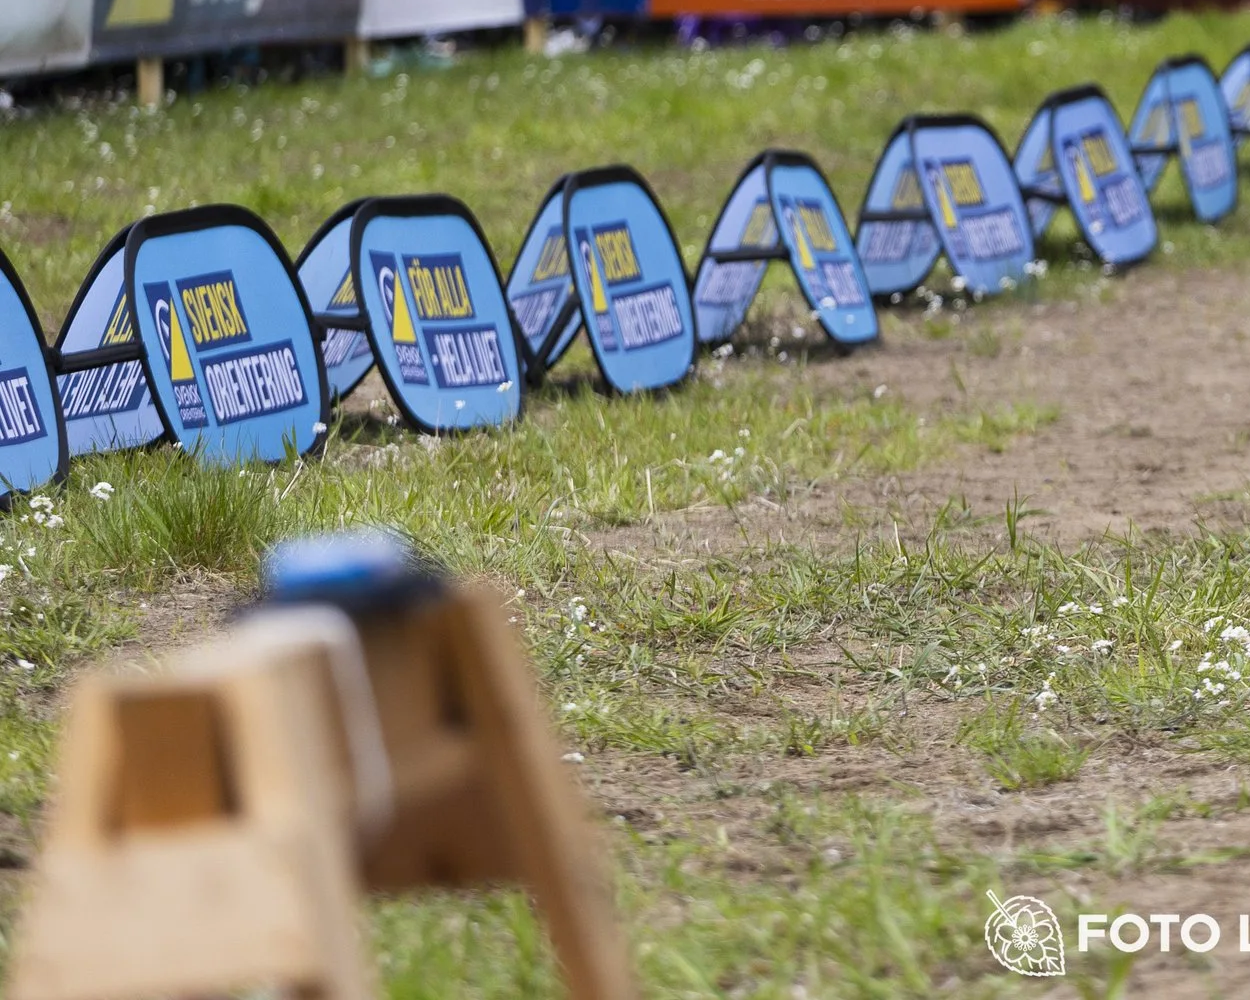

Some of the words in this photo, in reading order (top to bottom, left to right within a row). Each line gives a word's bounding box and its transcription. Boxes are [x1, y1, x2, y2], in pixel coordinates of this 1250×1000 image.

[182, 280, 247, 344] SVENSK
[408, 257, 442, 318] FÖR
[434, 265, 473, 317] ALLA
[205, 348, 303, 420] ORIENTERING
[434, 333, 475, 387] HELA
[465, 330, 506, 385] LIVET
[174, 384, 202, 406] SVENSK
